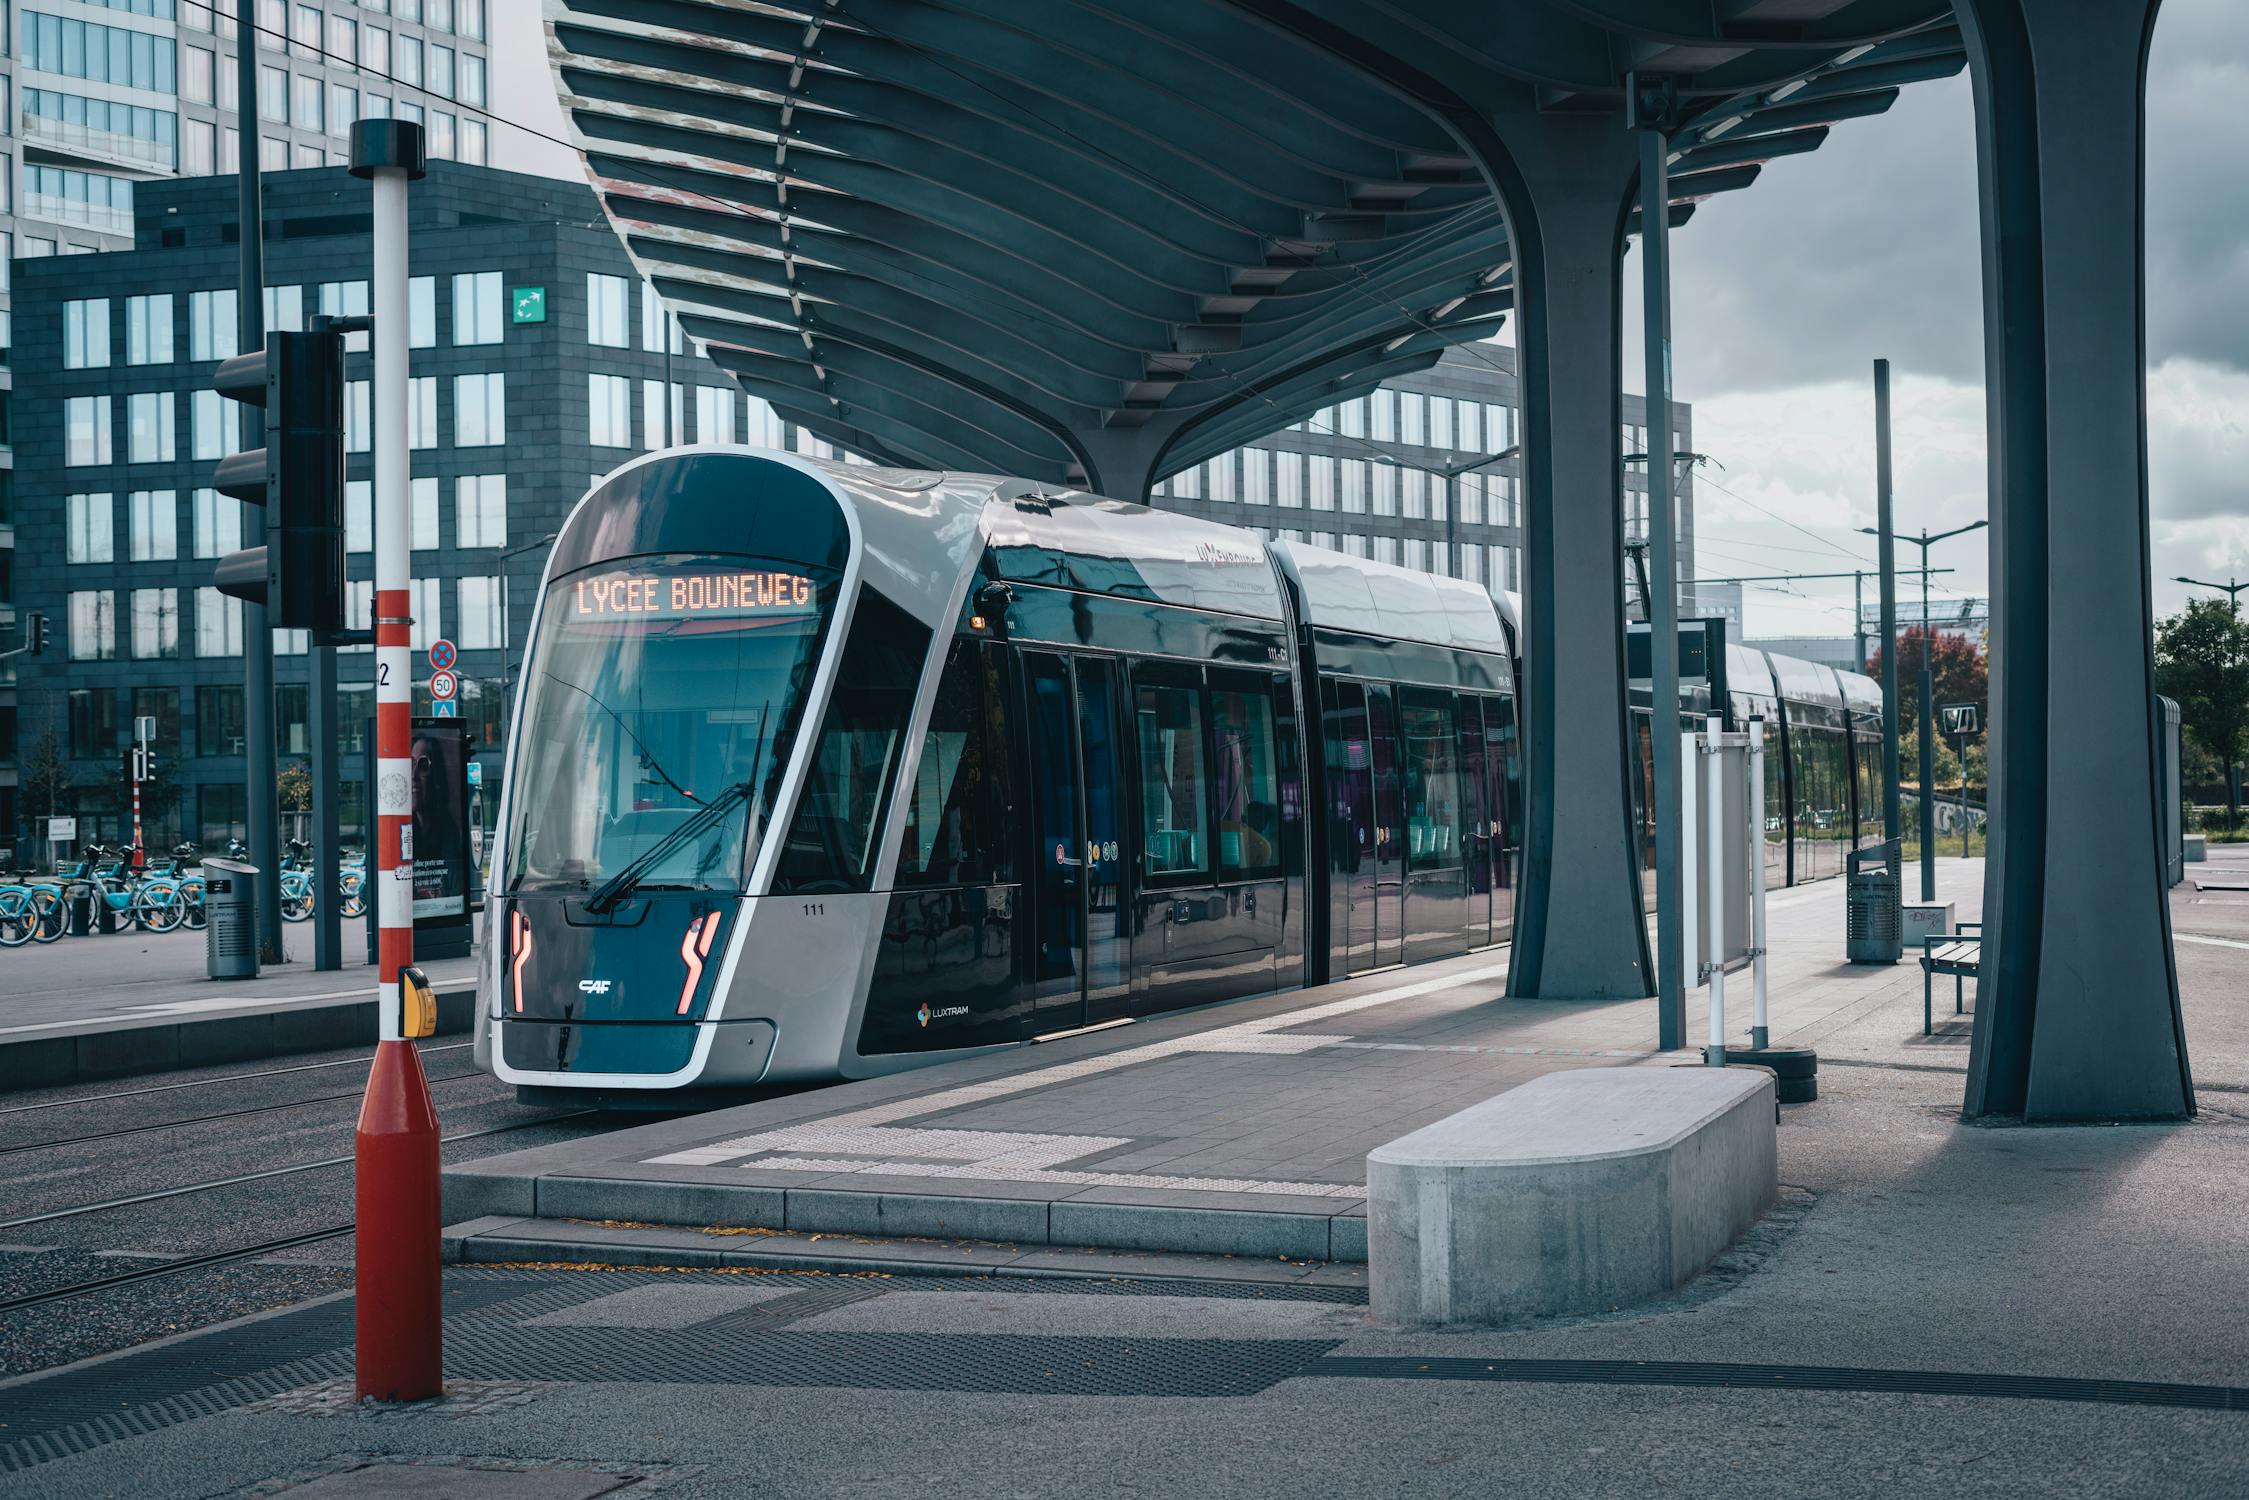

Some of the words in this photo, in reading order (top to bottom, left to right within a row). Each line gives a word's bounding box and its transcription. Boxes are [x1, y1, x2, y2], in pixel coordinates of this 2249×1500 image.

[577, 578, 660, 614] LYCEE
[671, 573, 809, 611] BOUNEWEG
[436, 679, 450, 692] 50
[802, 903, 824, 916] 111
[578, 979, 612, 994] CAF
[932, 1005, 969, 1018] LUXTRAM
